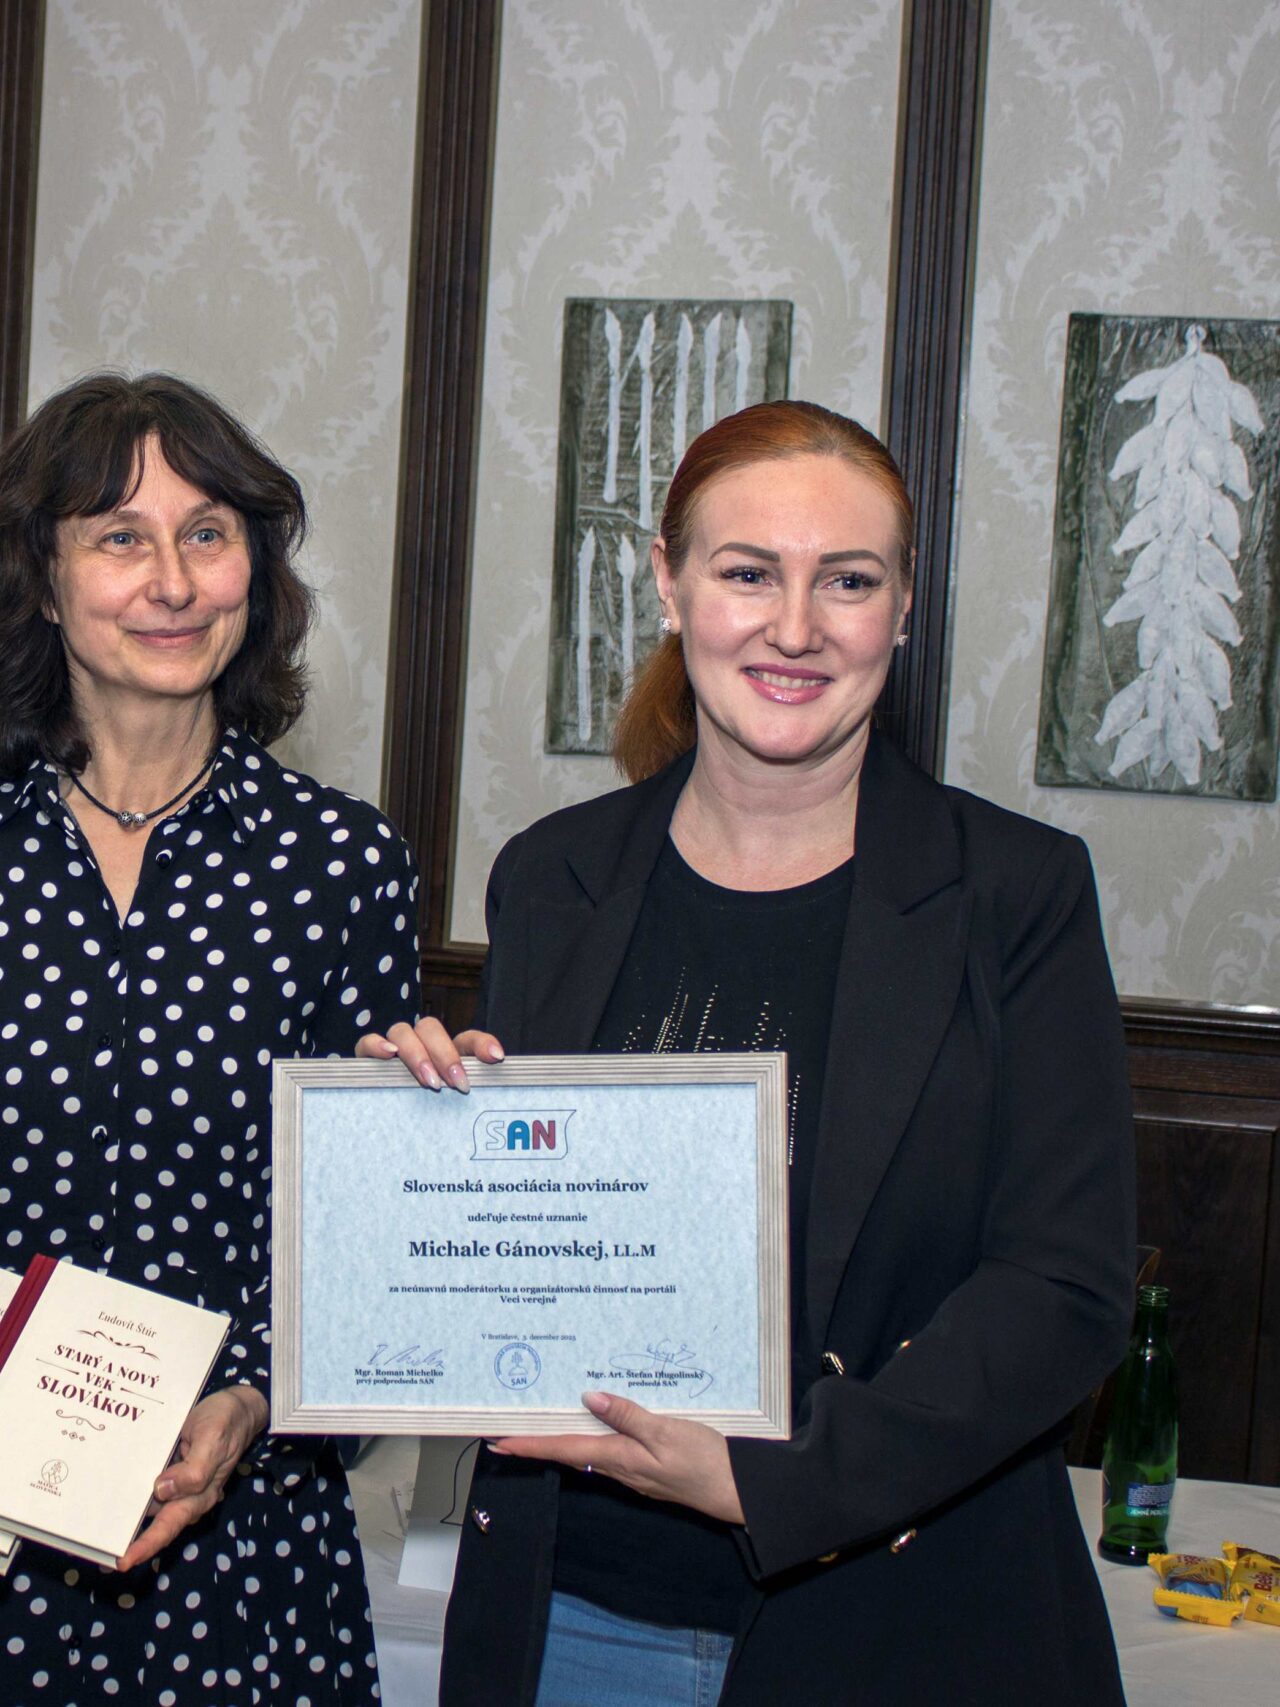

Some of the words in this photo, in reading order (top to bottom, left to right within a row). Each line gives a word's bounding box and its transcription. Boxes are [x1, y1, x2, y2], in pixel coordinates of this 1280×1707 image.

[485, 1120, 556, 1150] SAN
[403, 1179, 484, 1193] Slovenská
[488, 1179, 561, 1193] asociácia
[566, 1178, 649, 1192] novinárov
[467, 1212, 509, 1224] udeľuje
[510, 1211, 544, 1222] čestné
[546, 1212, 588, 1222] uznanie
[408, 1240, 490, 1257] Michale
[495, 1240, 609, 1261] Gánovskej,
[613, 1244, 656, 1257] LL.M
[389, 1286, 400, 1294] za
[401, 1285, 447, 1294] neúnavnú
[449, 1285, 511, 1294] moderátorku
[520, 1284, 591, 1295] organizátorskú
[593, 1284, 629, 1294] činnosť
[630, 1286, 642, 1294] na
[644, 1285, 677, 1295] portáli
[500, 1295, 521, 1304] Veci
[522, 1295, 558, 1306] verejné
[98, 1311, 135, 1331] Ľudovít
[135, 1322, 157, 1338] Štúr
[54, 1344, 103, 1369] STARÝ
[103, 1362, 113, 1374] A
[117, 1365, 160, 1388] NOVÝ
[375, 1368, 405, 1377] Roman
[406, 1368, 444, 1377] Michelko
[84, 1372, 116, 1391] VEK
[510, 1377, 527, 1386] SAN
[37, 1375, 145, 1422] SLOVÁKOV
